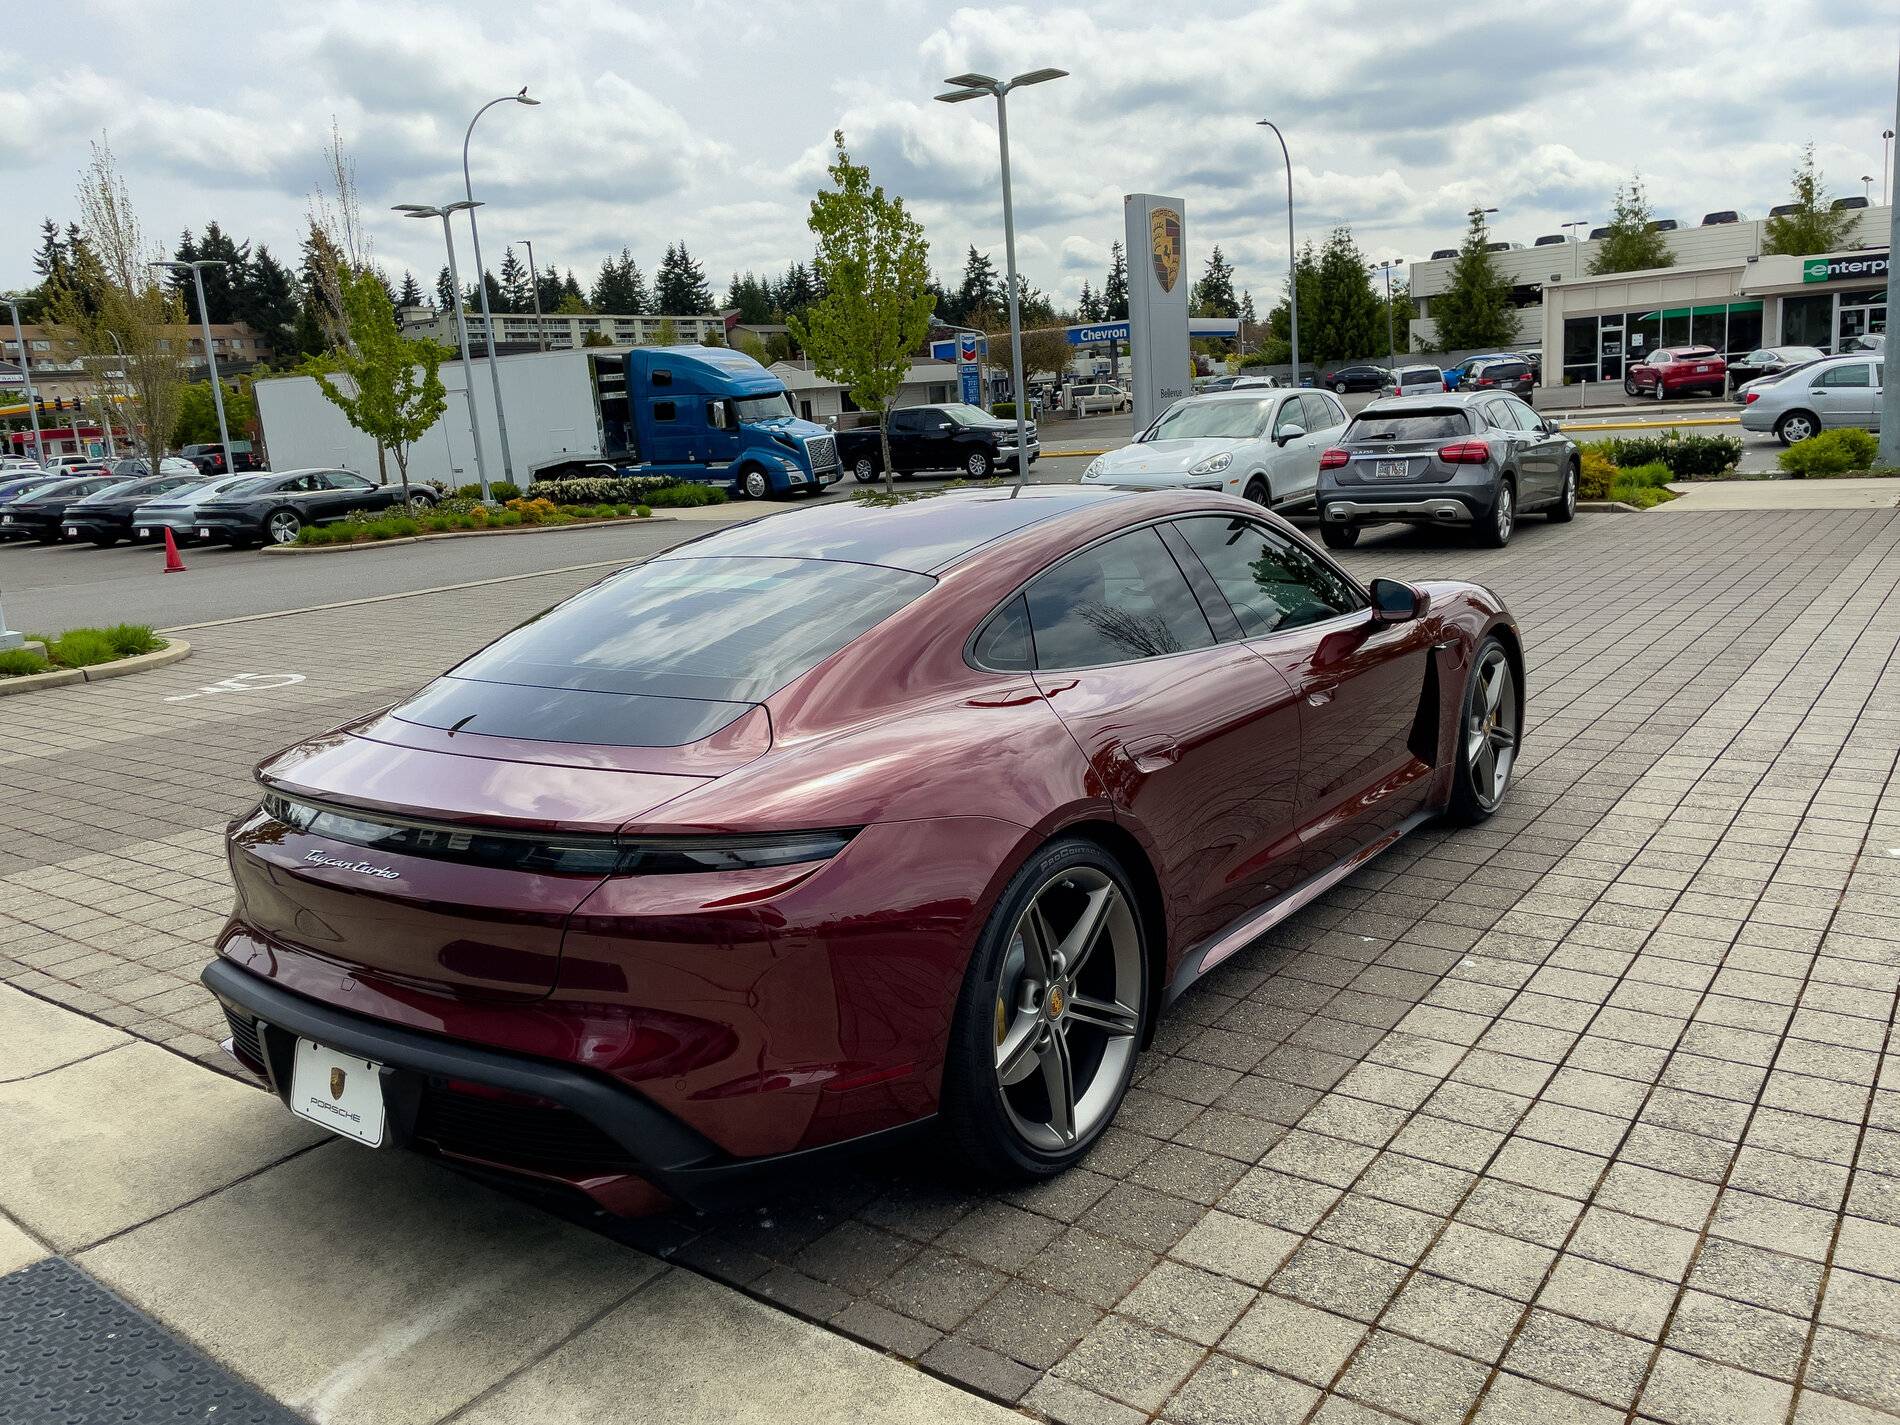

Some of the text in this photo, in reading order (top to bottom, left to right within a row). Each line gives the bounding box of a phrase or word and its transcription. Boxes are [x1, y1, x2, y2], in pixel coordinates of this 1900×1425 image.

[1080, 328, 1127, 341] Chevron
[304, 849, 401, 880] Taycan turbo
[310, 1097, 361, 1123] PORSCHE
